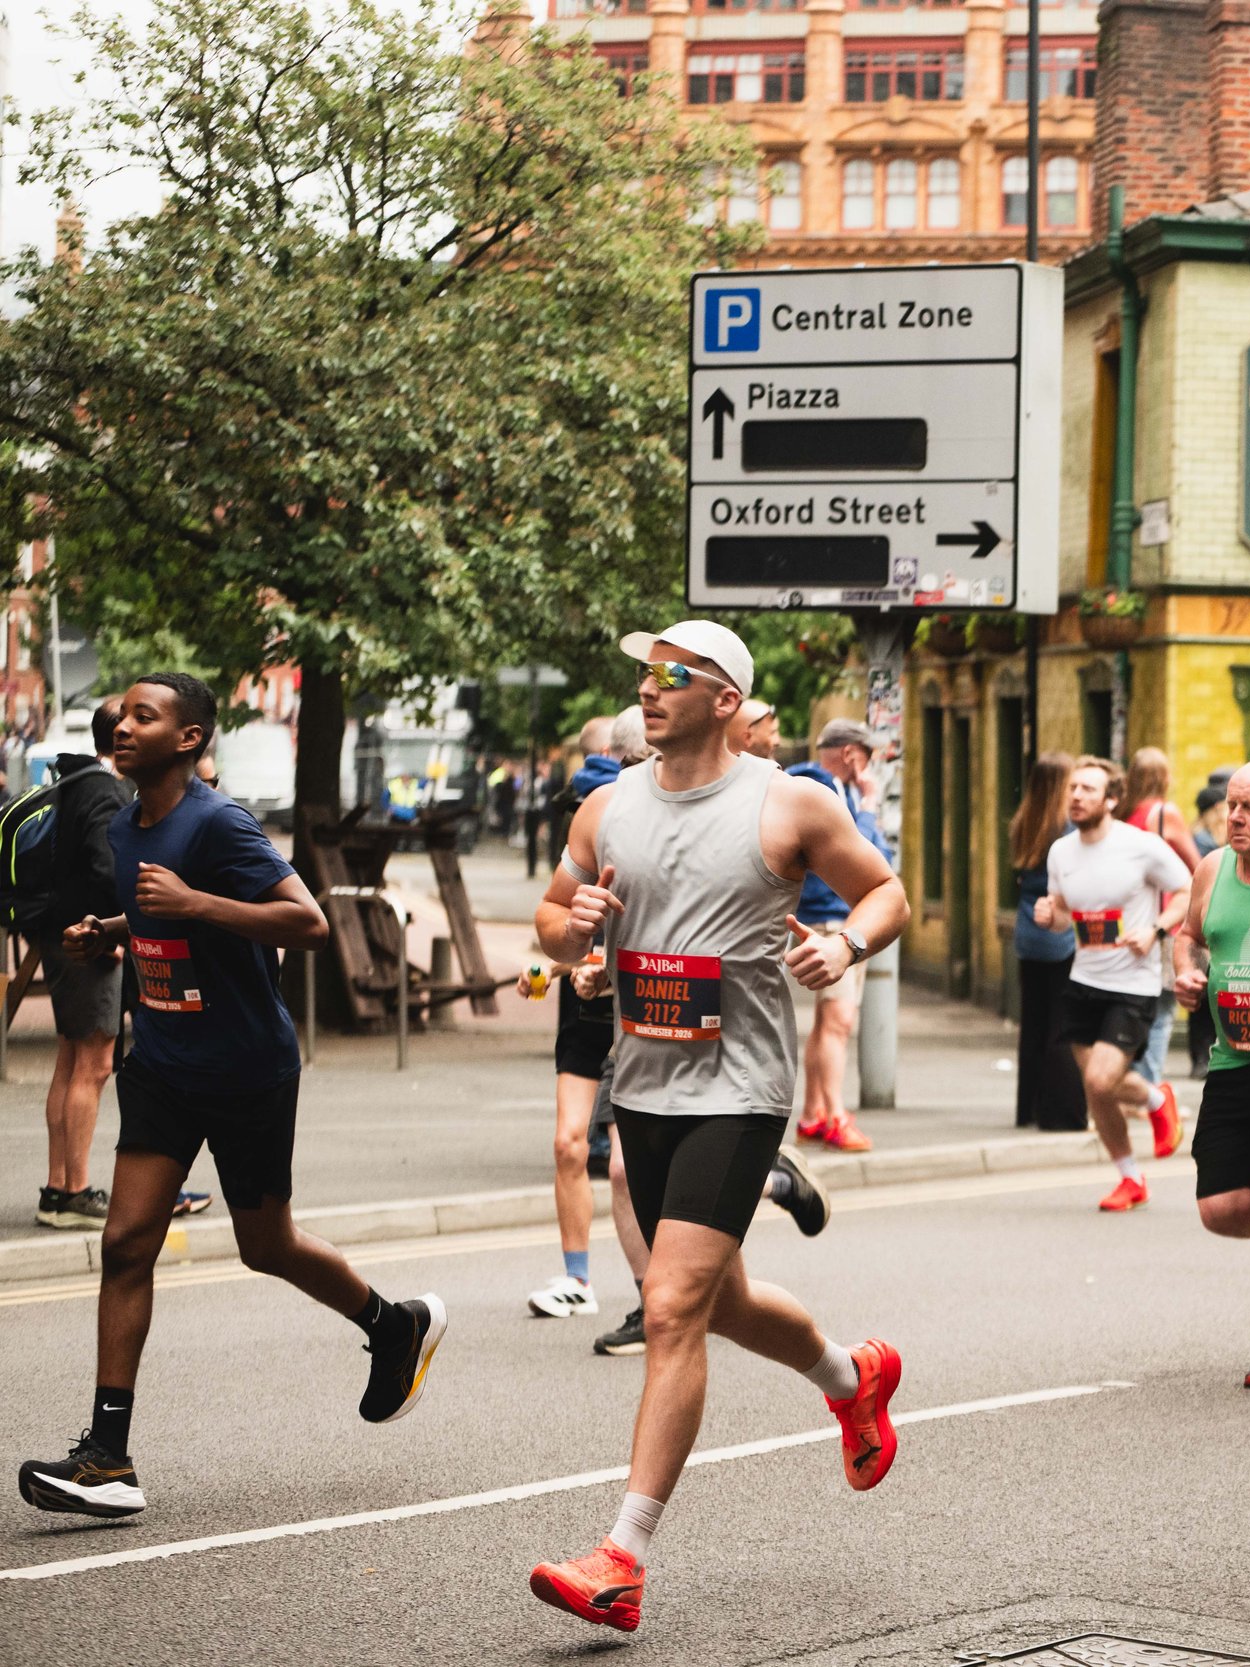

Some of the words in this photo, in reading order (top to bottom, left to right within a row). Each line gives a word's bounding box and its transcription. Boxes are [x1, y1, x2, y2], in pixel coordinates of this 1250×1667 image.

[718, 295, 752, 348] P
[771, 302, 887, 332] Central
[898, 301, 973, 329] Zone
[748, 383, 840, 410] Piazza
[711, 497, 814, 525] Oxford
[827, 496, 926, 525] Street
[647, 958, 685, 974] AJBell
[635, 978, 690, 1001] DANIEL
[643, 1002, 682, 1024] 2112
[704, 1018, 719, 1026] 10K
[635, 1025, 673, 1037] MANCHESTER
[674, 1029, 693, 1038] 2026
